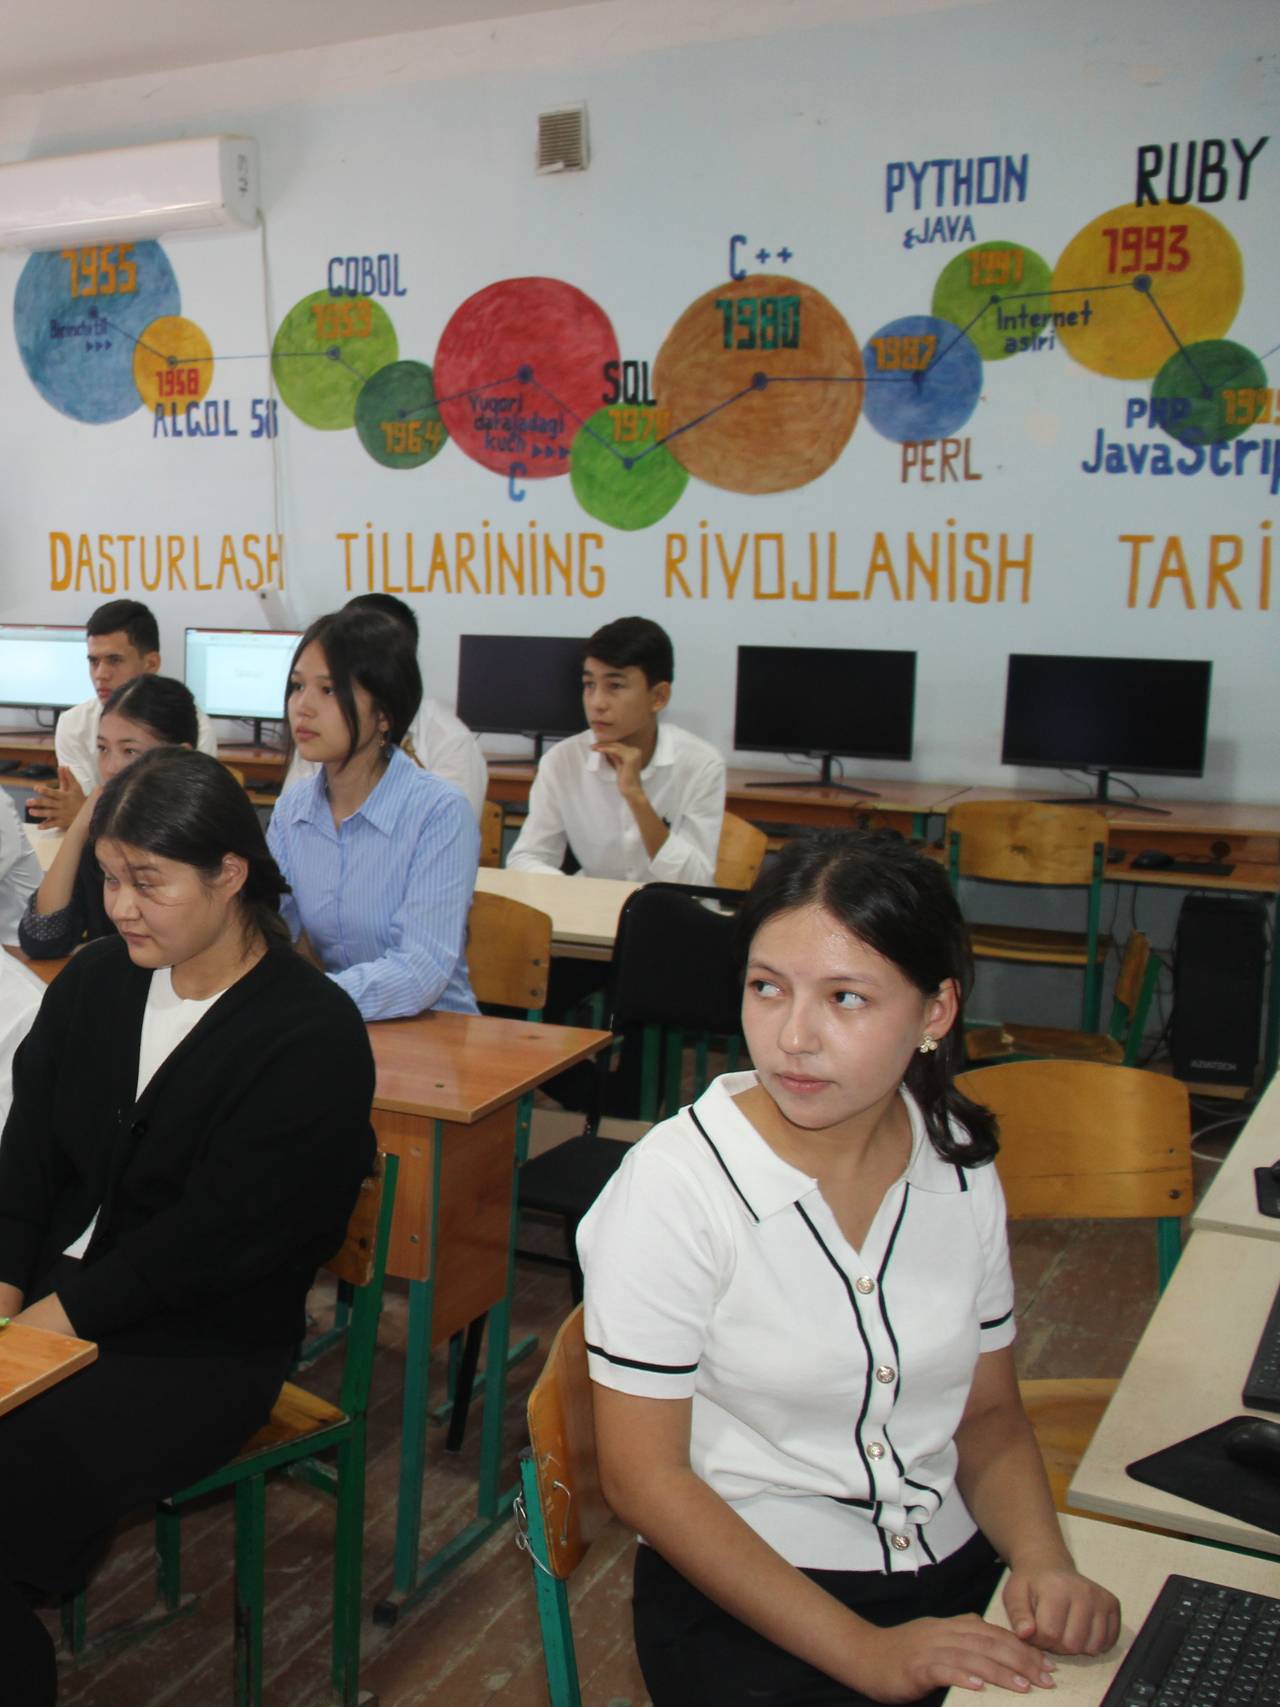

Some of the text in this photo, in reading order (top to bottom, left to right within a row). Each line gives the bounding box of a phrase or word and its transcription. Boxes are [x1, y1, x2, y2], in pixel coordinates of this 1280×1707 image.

[885, 153, 1029, 214] PYTHON
[1134, 135, 1271, 208] RUBY
[59, 242, 139, 298] 1955
[1101, 224, 1192, 275] 1993
[328, 253, 407, 298] COBOL
[714, 294, 801, 350] 1980
[156, 367, 200, 398] 1958
[602, 359, 658, 407] SQL
[508, 462, 528, 502] C
[901, 437, 982, 483] PERL
[49, 530, 285, 594] DASTURLASH
